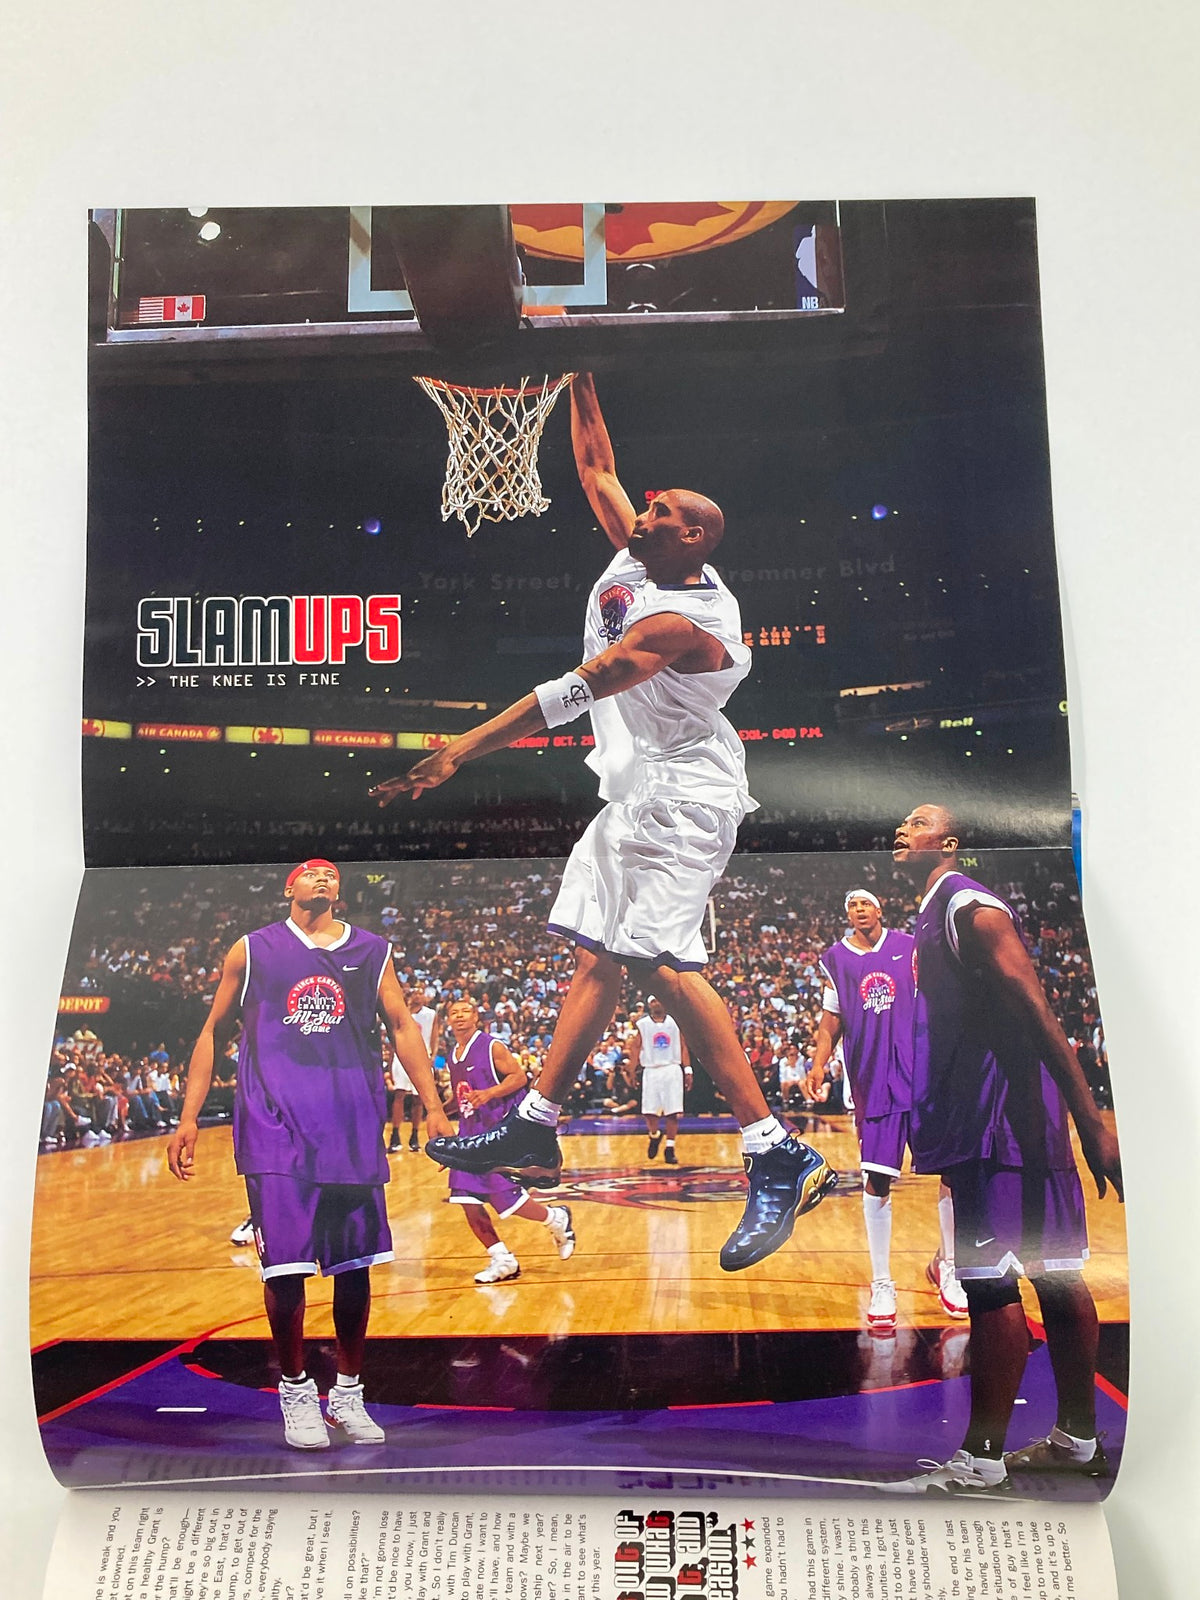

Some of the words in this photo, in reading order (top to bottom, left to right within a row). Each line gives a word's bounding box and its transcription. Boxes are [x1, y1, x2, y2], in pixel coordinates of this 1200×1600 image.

[802, 296, 826, 309] NB
[491, 572, 581, 592] Street,
[717, 567, 827, 583] remner
[840, 554, 895, 578] Blvd
[136, 594, 402, 668] SLAMUPS
[169, 675, 200, 688] THE
[212, 674, 253, 687] KNEE
[266, 673, 287, 686] IS
[299, 673, 340, 686] FINE
[136, 727, 156, 736] AIR
[159, 728, 204, 739] CANADA
[314, 734, 333, 743] AIR
[335, 734, 377, 745] CANADA
[293, 977, 315, 992] VINCE
[316, 976, 342, 994] CARTER
[282, 1009, 345, 1026] All-Star
[299, 1020, 331, 1036] Game
[139, 1507, 150, 1526] right
[239, 1508, 248, 1517] of
[252, 1509, 262, 1522] the
[379, 1510, 389, 1529] lose
[393, 1511, 403, 1532] have
[408, 1511, 418, 1528] just
[423, 1511, 431, 1528] and
[492, 1512, 502, 1530] how
[523, 1513, 530, 1525] we
[147, 1519, 161, 1545] Grant
[190, 1508, 206, 1546] different
[208, 1519, 218, 1534] out
[237, 1520, 247, 1535] out
[249, 1525, 259, 1538] for
[264, 1509, 278, 1539] staying
[307, 1515, 318, 1530] but
[322, 1521, 331, 1538] see
[449, 1511, 459, 1546] Duncan
[507, 1522, 515, 1541] with
[535, 1513, 545, 1538] year?
[846, 1518, 854, 1528] or
[861, 1518, 870, 1535] this
[875, 1519, 883, 1533] the
[888, 1518, 900, 1537] just
[917, 1519, 927, 1544] when
[945, 1520, 954, 1537] last
[959, 1520, 970, 1544] team
[1029, 1521, 1040, 1542] take
[1057, 1522, 1067, 1534] So
[100, 1545, 111, 1572] weak
[106, 1525, 116, 1542] and
[111, 1507, 121, 1522] you
[132, 1528, 144, 1553] team
[347, 1510, 361, 1572] possibilities?
[479, 1524, 487, 1546] want
[761, 1516, 773, 1563] expanded
[777, 1529, 785, 1548] had
[805, 1528, 816, 1556] game
[847, 1530, 857, 1552] third
[903, 1519, 915, 1546] green
[972, 1520, 985, 1555] enough
[986, 1520, 998, 1548] here?
[1046, 1534, 1055, 1547] up
[204, 1537, 216, 1552] big
[233, 1538, 243, 1553] get
[376, 1532, 387, 1562] gonna
[419, 1531, 430, 1558] Grant
[431, 1576, 441, 1589] So
[436, 1511, 447, 1535] really
[492, 1534, 501, 1552] and
[519, 1531, 531, 1564] Maybe
[563, 1543, 572, 1556] air
[862, 1540, 872, 1559] had
[876, 1536, 887, 1552] got
[946, 1541, 956, 1551] of
[157, 1537, 171, 1571] hump?
[202, 1555, 211, 1568] so
[317, 1547, 328, 1574] when
[391, 1547, 400, 1567] nice
[447, 1551, 457, 1569] Tim
[463, 1543, 472, 1563] with
[506, 1544, 515, 1563] and
[535, 1545, 543, 1566] next
[906, 1549, 915, 1565] the
[963, 1548, 972, 1563] his
[1020, 1550, 1029, 1568] like
[128, 1555, 138, 1574] this
[140, 1550, 155, 1587] healthy
[244, 1541, 256, 1585] compete
[257, 1542, 273, 1593] everybody
[418, 1561, 427, 1582] with
[563, 1561, 572, 1578] the
[807, 1558, 815, 1577] this
[920, 1546, 931, 1590] shoulder
[949, 1556, 959, 1575] end
[992, 1550, 1003, 1594] situation
[1007, 1554, 1017, 1572] guy
[1035, 1558, 1044, 1574] me
[155, 1575, 165, 1591] the
[375, 1566, 384, 1582] not
[404, 1573, 413, 1591] you
[461, 1566, 472, 1587] play
[505, 1567, 514, 1593] team
[764, 1568, 775, 1597] game
[866, 1564, 874, 1599] always
[894, 1567, 902, 1580] do
[908, 1569, 917, 1594] have
[965, 1567, 973, 1581] for
[978, 1562, 989, 1595] having
[1022, 1572, 1031, 1591] feel
[1050, 1571, 1060, 1590] and
[446, 1574, 456, 1596] with
[591, 1574, 600, 1593] this
[808, 1580, 816, 1600] had
[951, 1580, 960, 1596] the
[1007, 1578, 1017, 1589] of
[1065, 1575, 1074, 1592] me
